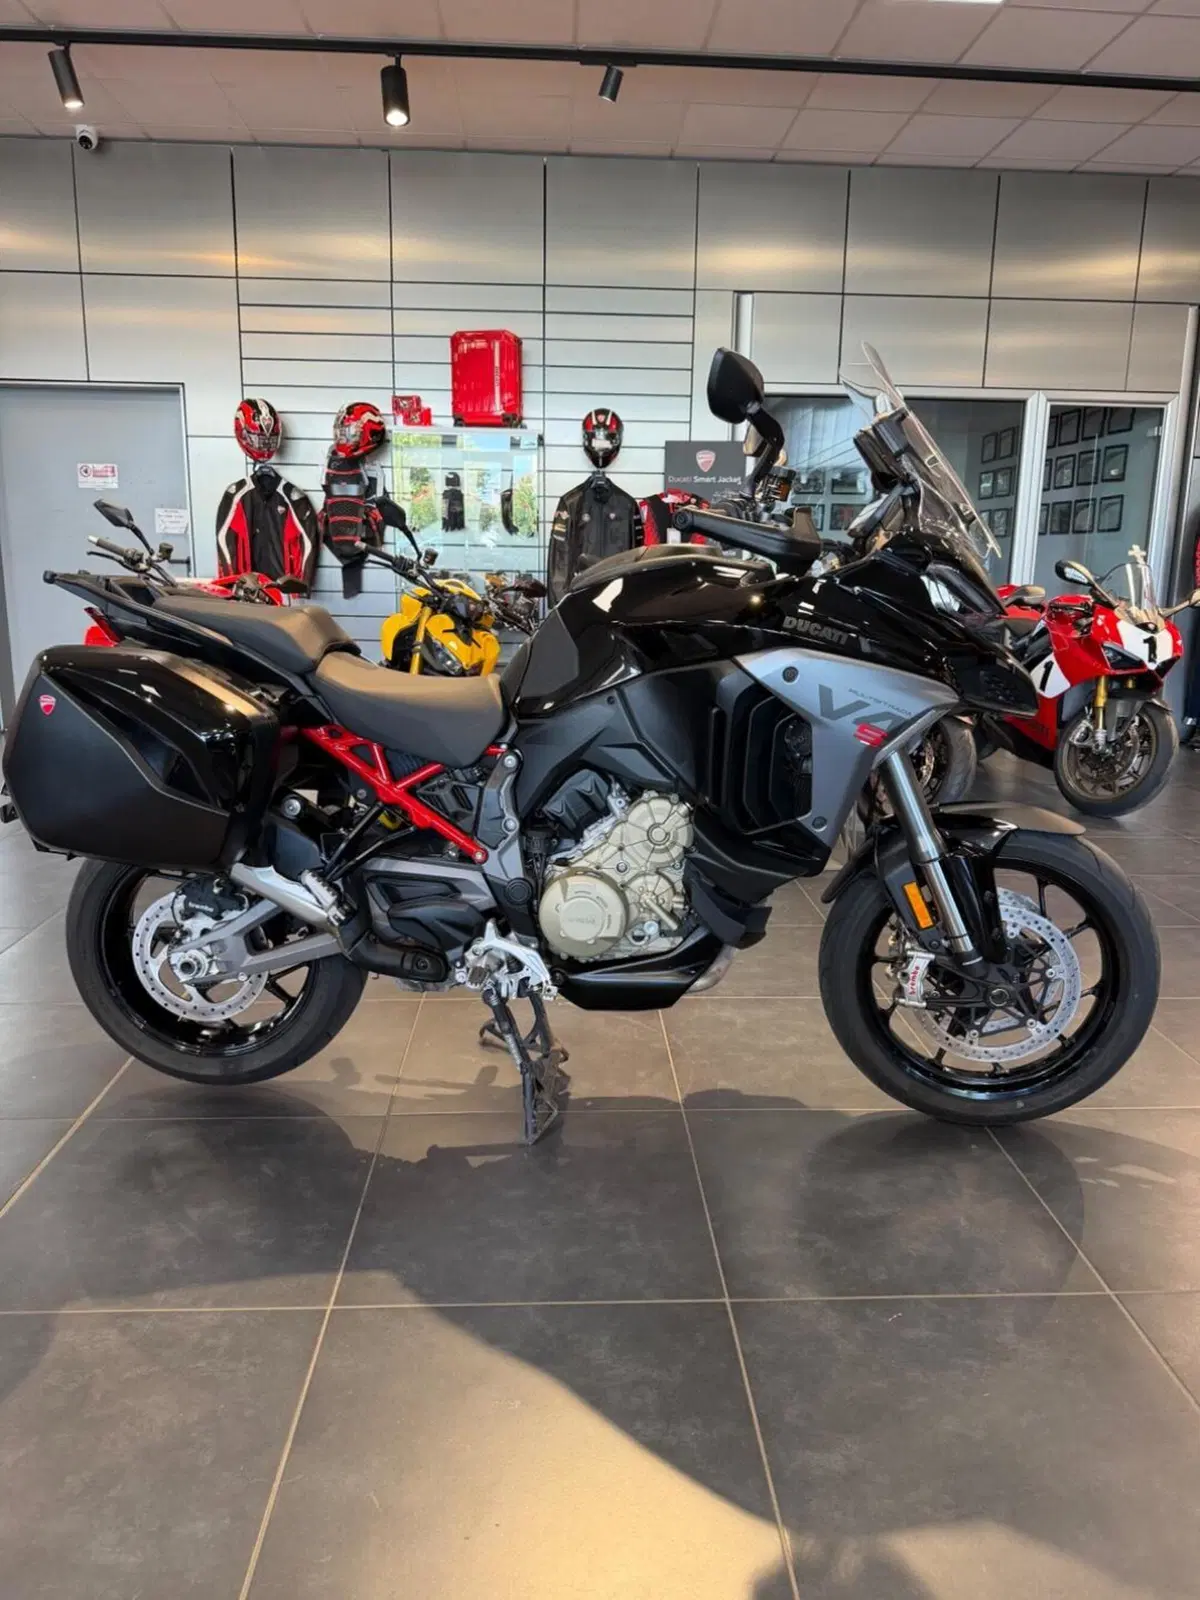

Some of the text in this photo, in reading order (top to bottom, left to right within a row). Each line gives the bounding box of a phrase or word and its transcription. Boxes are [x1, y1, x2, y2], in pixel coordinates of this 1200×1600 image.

[693, 475, 716, 483] Smart
[718, 476, 741, 485] Jacket
[783, 616, 848, 645] DUCATI
[1142, 635, 1158, 663] 1
[1039, 660, 1053, 692] 1
[908, 965, 920, 995] brembo
